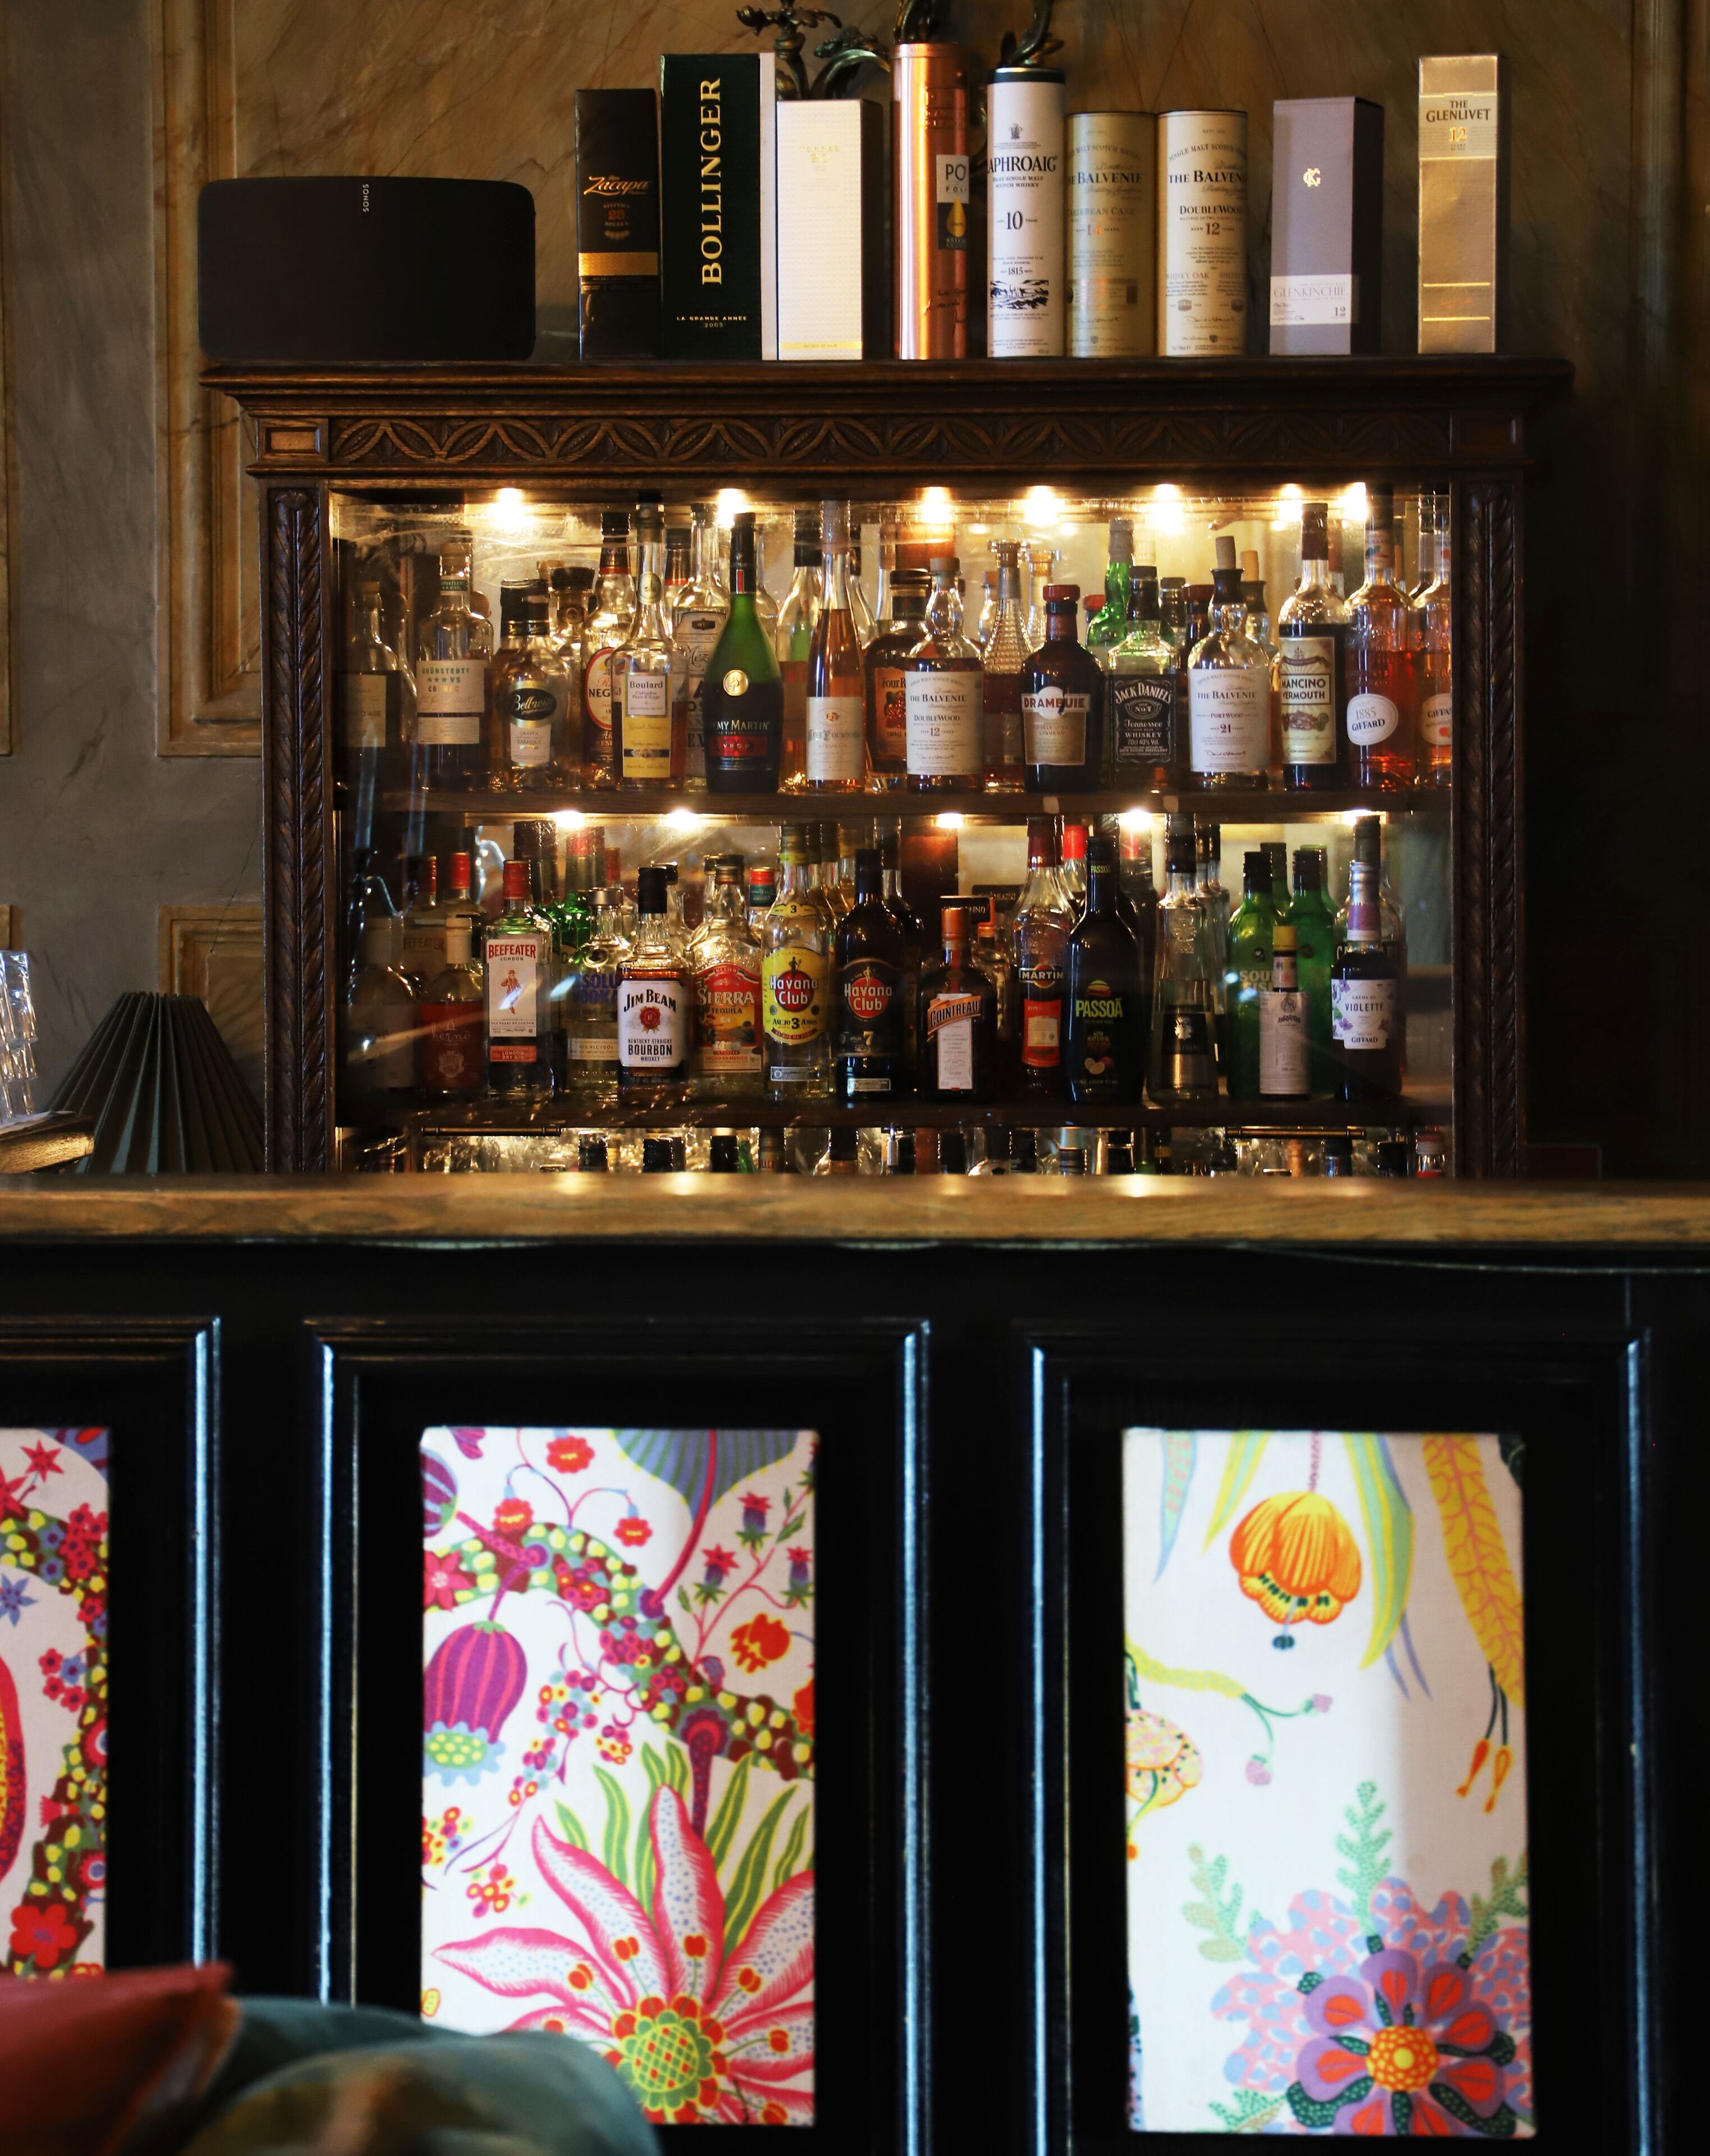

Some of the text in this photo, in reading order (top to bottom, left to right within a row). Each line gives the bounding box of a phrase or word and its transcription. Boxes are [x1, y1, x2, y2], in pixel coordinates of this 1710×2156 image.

[1450, 100, 1468, 108] THE
[1426, 108, 1491, 122] GLENLIVET
[1449, 126, 1467, 142] 12
[1191, 144, 1209, 152] MALT
[700, 77, 722, 285] BOLLINGER
[1169, 174, 1189, 184] THE
[583, 176, 649, 195] Zacapa
[1006, 211, 1023, 230] 10
[1206, 222, 1220, 235] 12
[1007, 267, 1024, 276] 1815
[1274, 286, 1346, 298] GLENKINCHIE
[1334, 306, 1346, 316] 12
[630, 680, 663, 689] Boulard
[1282, 678, 1326, 688] MANCINO
[922, 693, 965, 702] BALVENIE
[1114, 682, 1173, 705] JACK DANIEL'S
[1212, 691, 1256, 699] BALVENIE
[1282, 691, 1325, 699] VERMOUTH
[1024, 697, 1085, 709] DRAMBUIE
[914, 714, 960, 722] DOUBLEWOOD
[1355, 706, 1376, 720] 1885
[717, 719, 768, 730] MY MARTIN
[1124, 719, 1162, 728] Tennessee
[1220, 724, 1232, 733] 21
[1352, 718, 1385, 732] GIFFARD
[930, 727, 941, 737] 12
[790, 905, 797, 913] 3
[488, 944, 536, 959] BEEFEATER
[1022, 971, 1064, 980] MARTIN
[769, 975, 818, 990] Havana
[844, 983, 892, 997] Havana
[624, 989, 677, 1013] JIM BEAM
[697, 987, 755, 1006] SIERRA
[778, 990, 809, 1005] Club
[853, 997, 883, 1011] Club
[1345, 1002, 1384, 1012] VIOLETTE
[929, 1000, 979, 1029] COINTREAU
[791, 1017, 800, 1030] 3
[863, 1030, 874, 1047] 7
[628, 1044, 672, 1056] BOURBON
